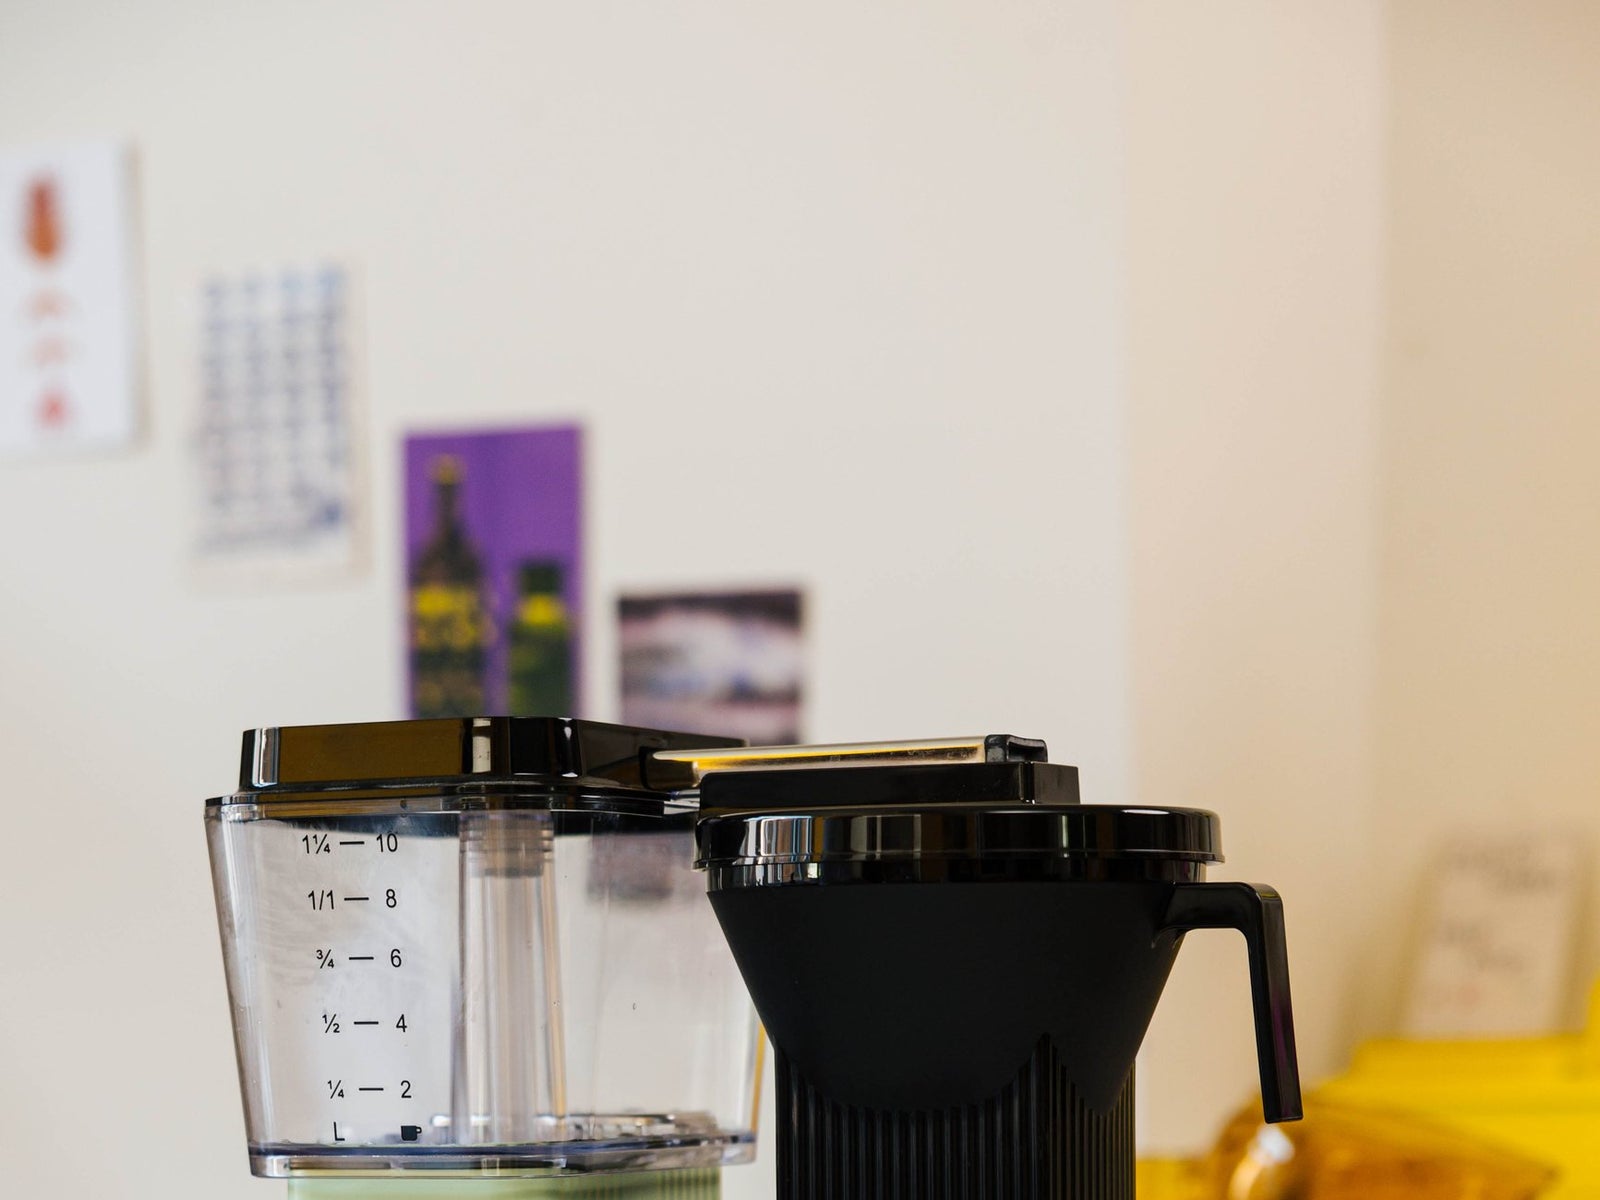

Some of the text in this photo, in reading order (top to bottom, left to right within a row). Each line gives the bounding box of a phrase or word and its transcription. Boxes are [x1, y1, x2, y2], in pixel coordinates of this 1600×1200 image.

[376, 833, 398, 853] 10
[308, 888, 397, 910] 1/1 8
[390, 948, 402, 968] 6
[396, 1014, 407, 1033] 4
[400, 1080, 412, 1099] 2
[333, 1122, 345, 1141] L
